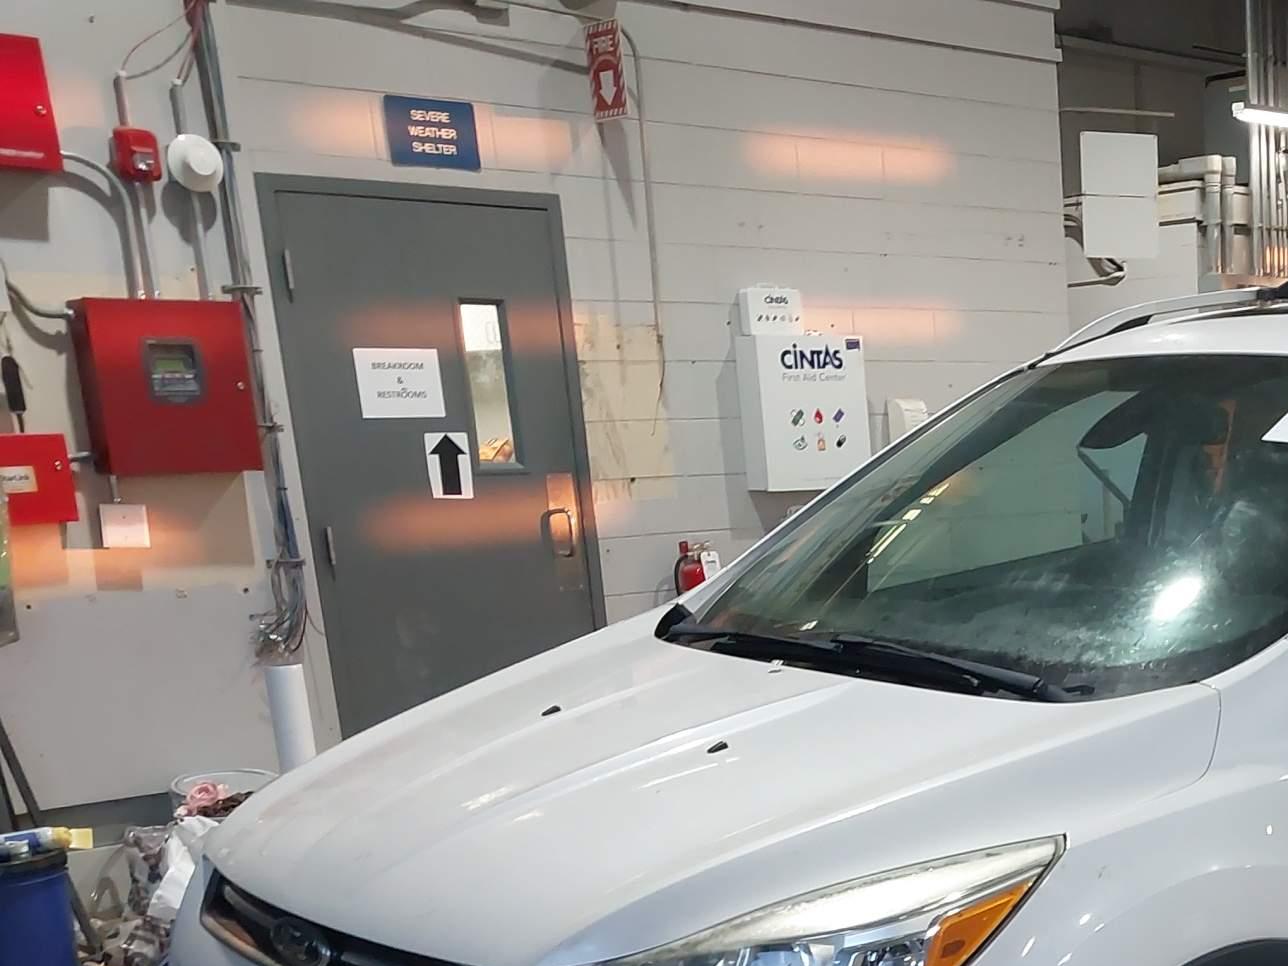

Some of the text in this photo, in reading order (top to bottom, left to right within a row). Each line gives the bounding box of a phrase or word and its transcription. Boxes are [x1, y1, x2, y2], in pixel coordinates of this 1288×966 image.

[592, 35, 615, 55] FIRE
[409, 109, 451, 124] SEVERE
[407, 125, 458, 140] WEATHER
[412, 141, 458, 156] SHELTER
[780, 343, 843, 370] CINTAS
[782, 372, 847, 382] First Aid Center
